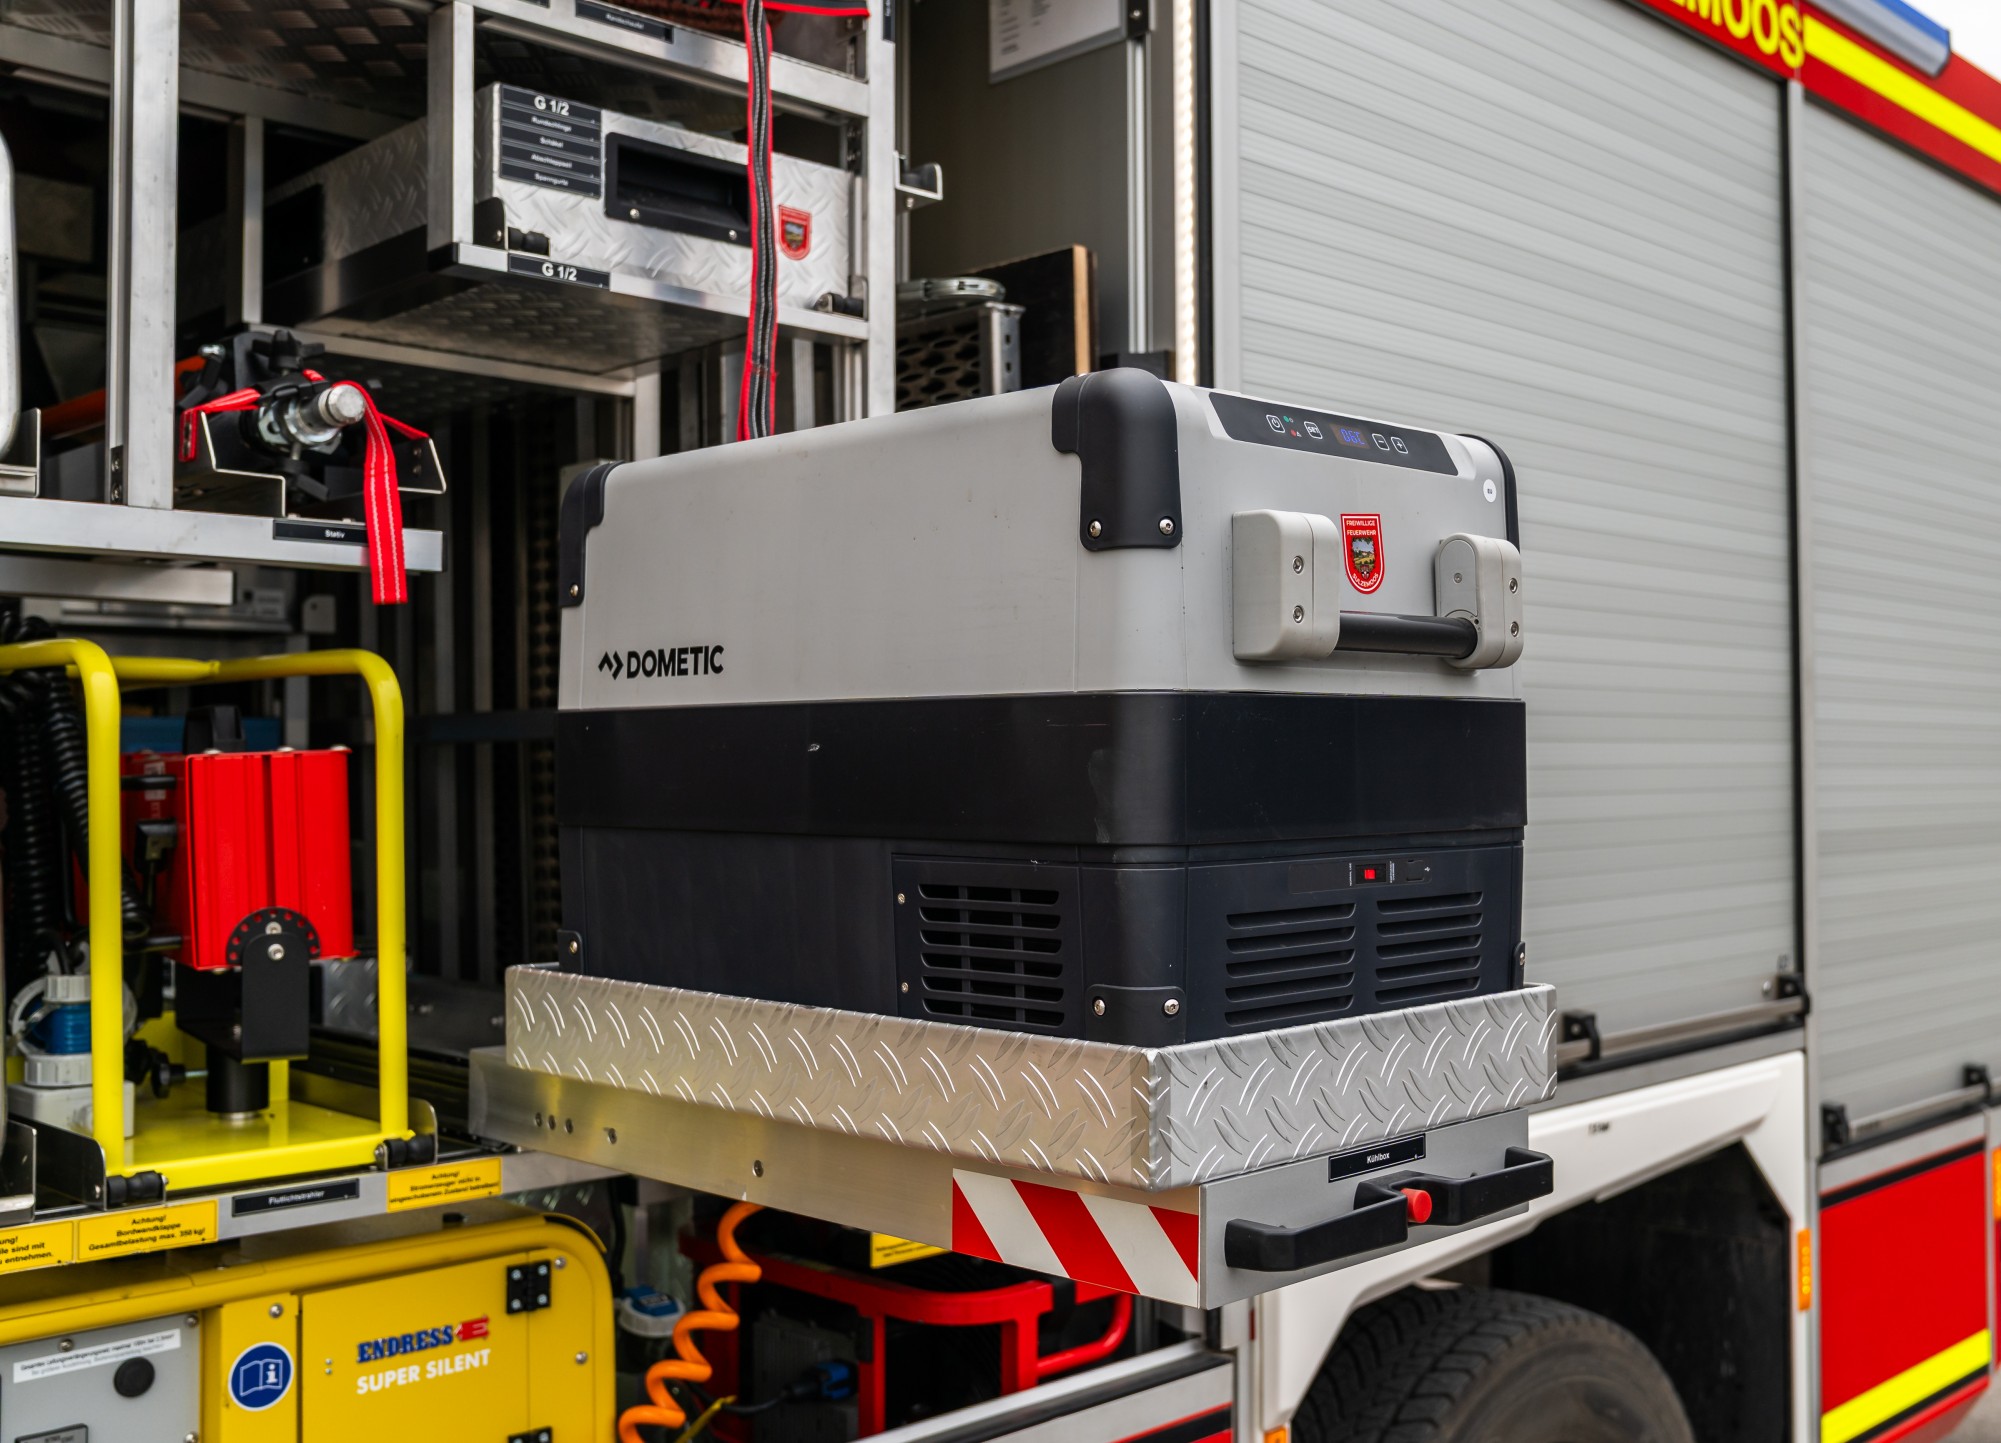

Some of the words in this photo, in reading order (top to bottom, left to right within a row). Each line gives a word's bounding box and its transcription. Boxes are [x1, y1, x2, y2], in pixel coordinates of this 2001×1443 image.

[533, 95, 547, 110] G
[549, 99, 570, 116] 1/2
[541, 262, 554, 277] G
[557, 265, 577, 281] 1/2
[325, 529, 346, 539] Stativ
[627, 645, 724, 679] DOMETIC
[1366, 1152, 1390, 1164] Kühlbox
[132, 1215, 166, 1225] Achtung!
[116, 1223, 181, 1237] Bordwandklappe
[12, 1245, 29, 1253] sind
[89, 1236, 157, 1251] Gesamtbelastung
[5, 1252, 53, 1264] entnehmen.
[356, 1324, 454, 1364] ENDRESS
[356, 1364, 421, 1395] SUPER
[425, 1348, 491, 1379] SILENT
